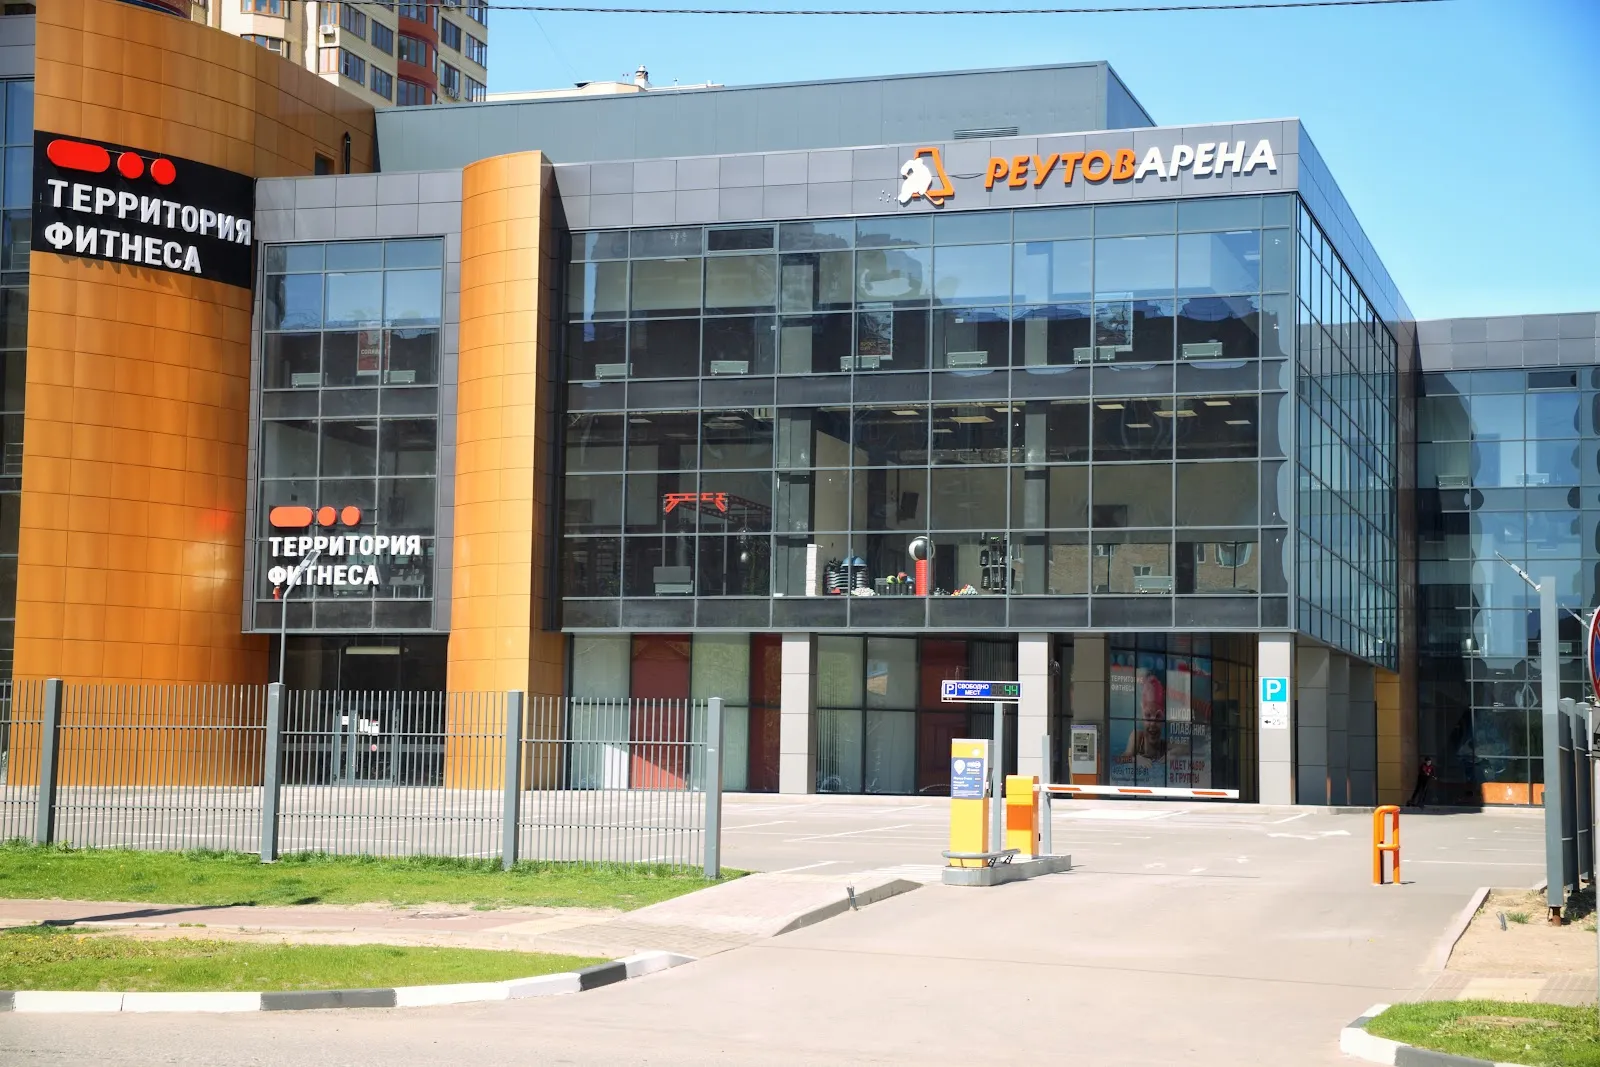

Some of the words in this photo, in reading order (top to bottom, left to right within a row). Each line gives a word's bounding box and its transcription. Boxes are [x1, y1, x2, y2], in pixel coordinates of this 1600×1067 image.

[47, 178, 252, 246] ТЕРРИТОРИЯ
[44, 221, 202, 274] ФИТНЕСА
[268, 535, 421, 557] ТЕРРИТОРИЯ
[267, 565, 380, 586] ФИТНЕСА
[946, 684, 954, 695] P
[1004, 684, 1018, 696] 44
[1266, 679, 1282, 701] P
